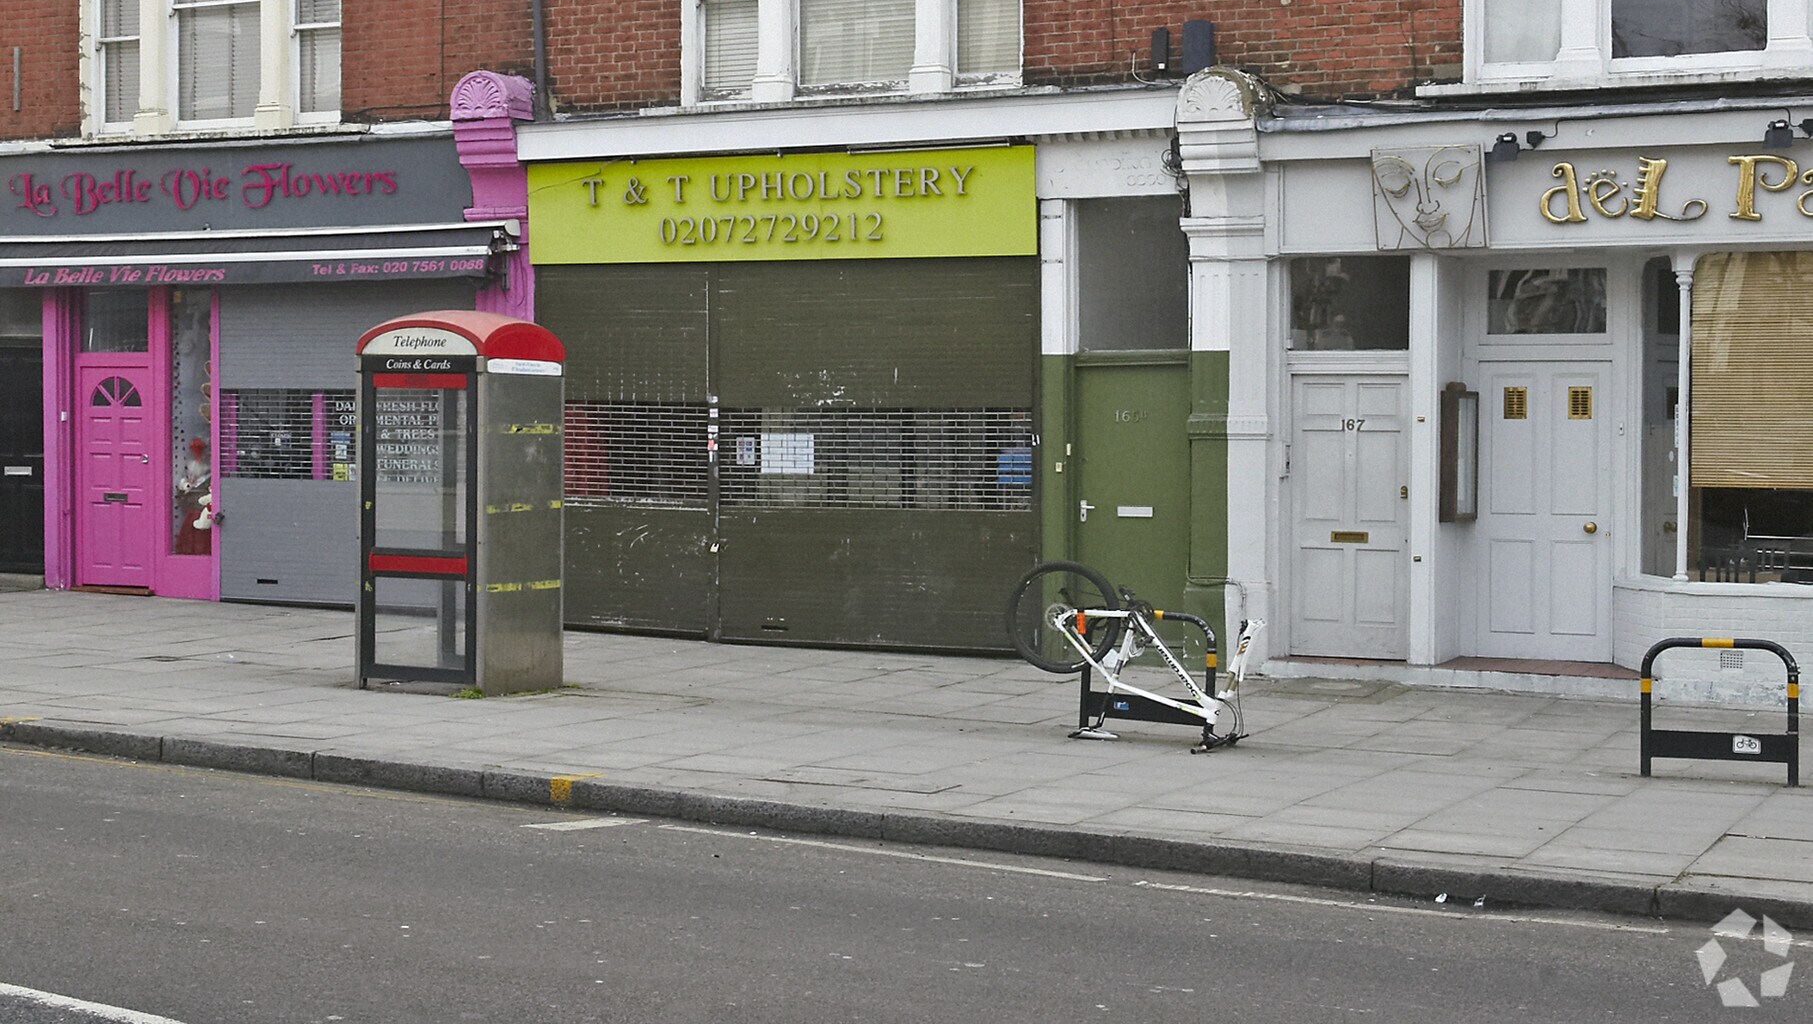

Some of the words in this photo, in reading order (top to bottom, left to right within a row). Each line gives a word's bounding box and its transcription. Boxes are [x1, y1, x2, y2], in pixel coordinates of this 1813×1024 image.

[9, 173, 57, 218] La
[61, 168, 151, 217] Belle
[160, 167, 229, 210] Vie
[241, 162, 399, 209] Flowers
[582, 178, 604, 206] T
[622, 176, 648, 205] &
[667, 175, 690, 203] T
[709, 165, 975, 202] UPHOLSTERY
[658, 211, 884, 245] 02072729212
[24, 269, 50, 285] La
[54, 268, 104, 284] Belle
[108, 267, 141, 284] Vie
[144, 265, 225, 283] Flowers
[312, 262, 333, 275] Tel
[336, 262, 347, 274] &
[350, 262, 380, 275] Fax:
[383, 261, 409, 273] 020
[412, 260, 446, 273] 7561
[450, 259, 484, 271] 0068
[393, 336, 447, 349] Telephone
[386, 359, 411, 370] Coins
[413, 359, 422, 369] &
[424, 359, 451, 370] Cards
[1341, 419, 1365, 432] 167
[395, 428, 435, 440] TREES
